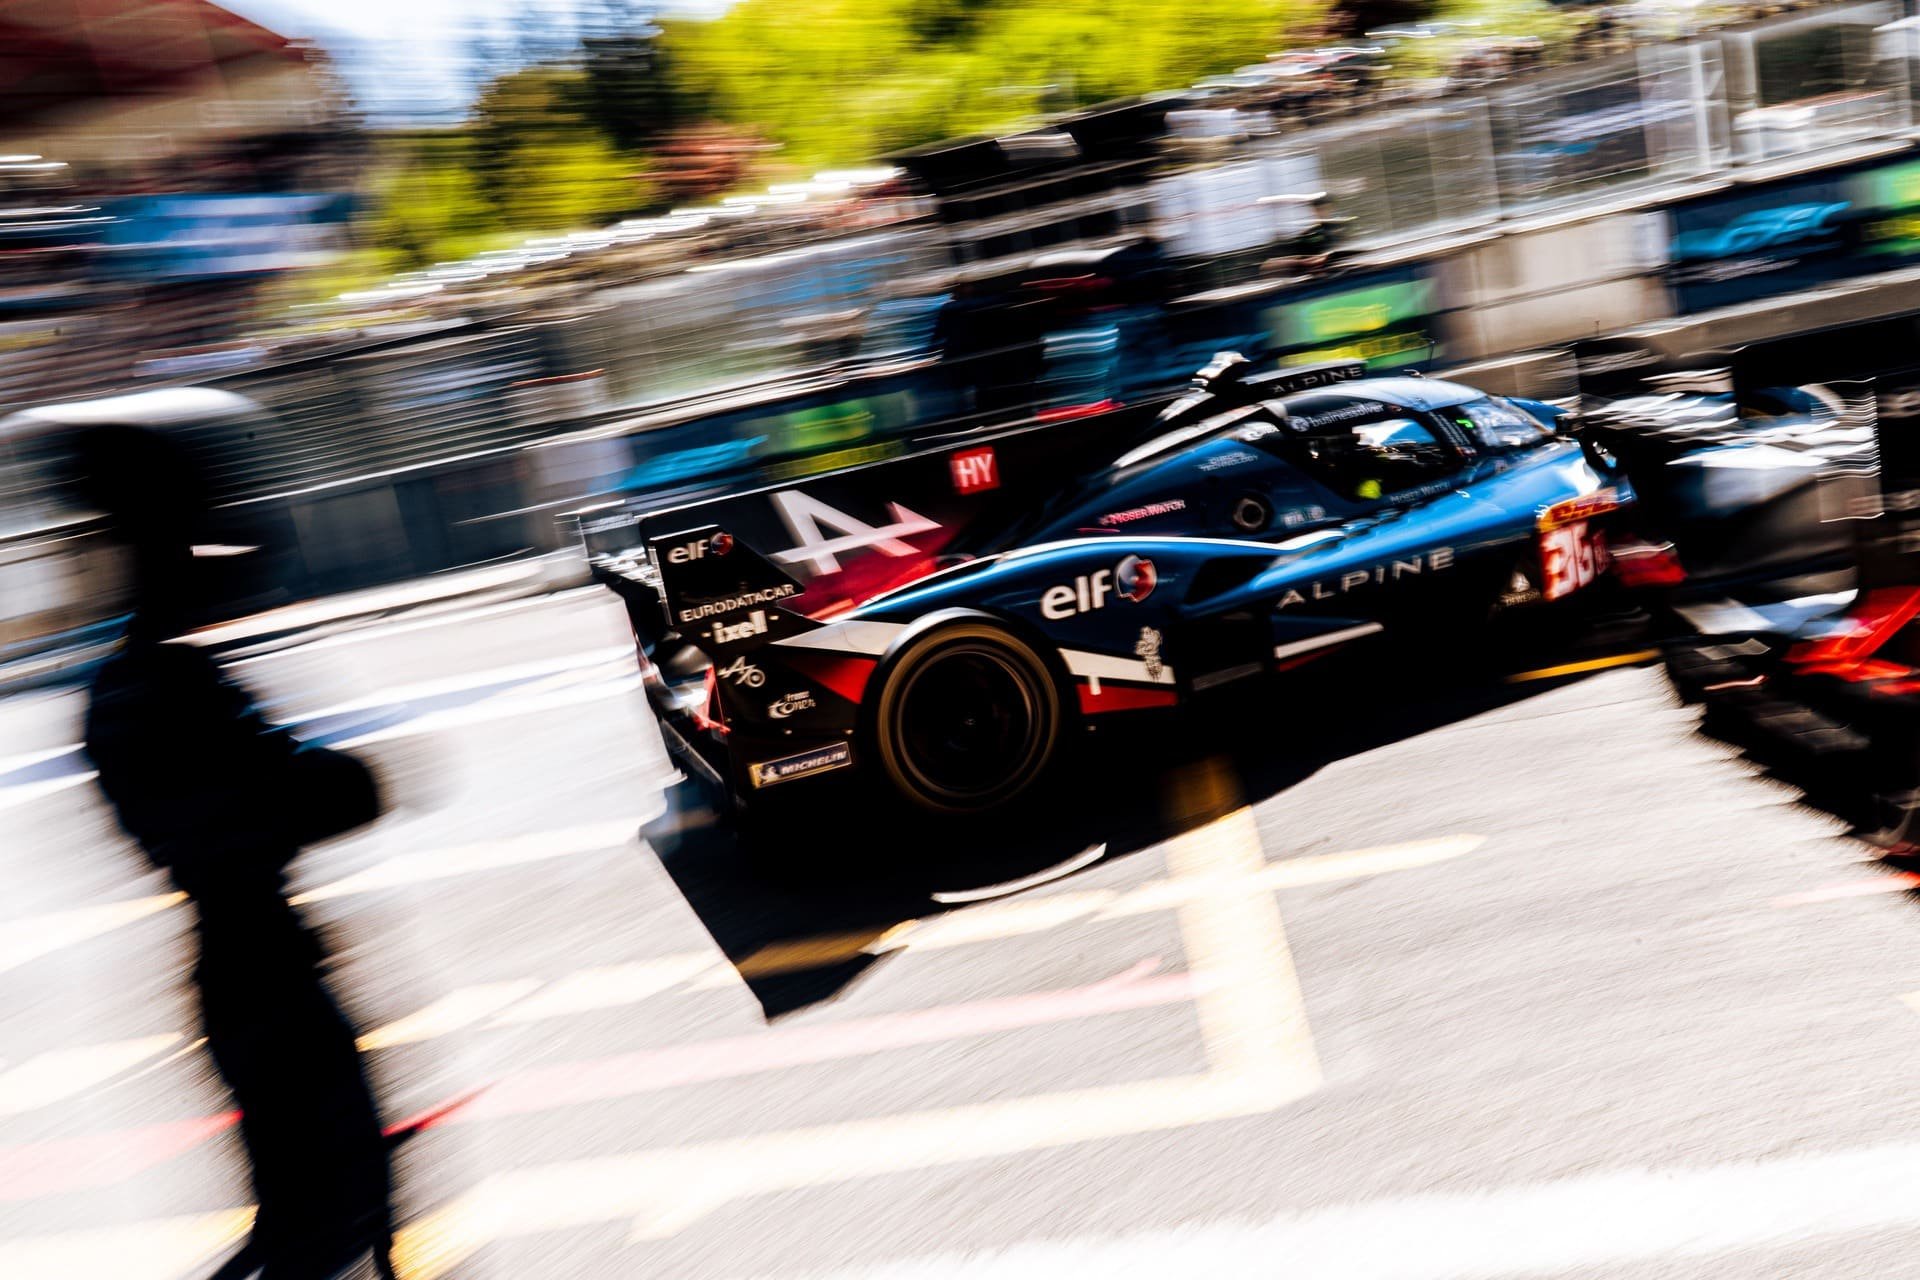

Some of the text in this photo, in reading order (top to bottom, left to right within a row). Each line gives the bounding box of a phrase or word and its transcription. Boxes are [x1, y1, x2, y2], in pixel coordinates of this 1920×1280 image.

[1272, 366, 1363, 394] ALPINE
[951, 453, 993, 488] HY
[667, 538, 710, 564] elf
[1040, 568, 1113, 620] elf
[1275, 546, 1455, 610] ALPINE
[679, 583, 796, 623] EURODATACAR
[780, 750, 848, 776] MICHELIN
